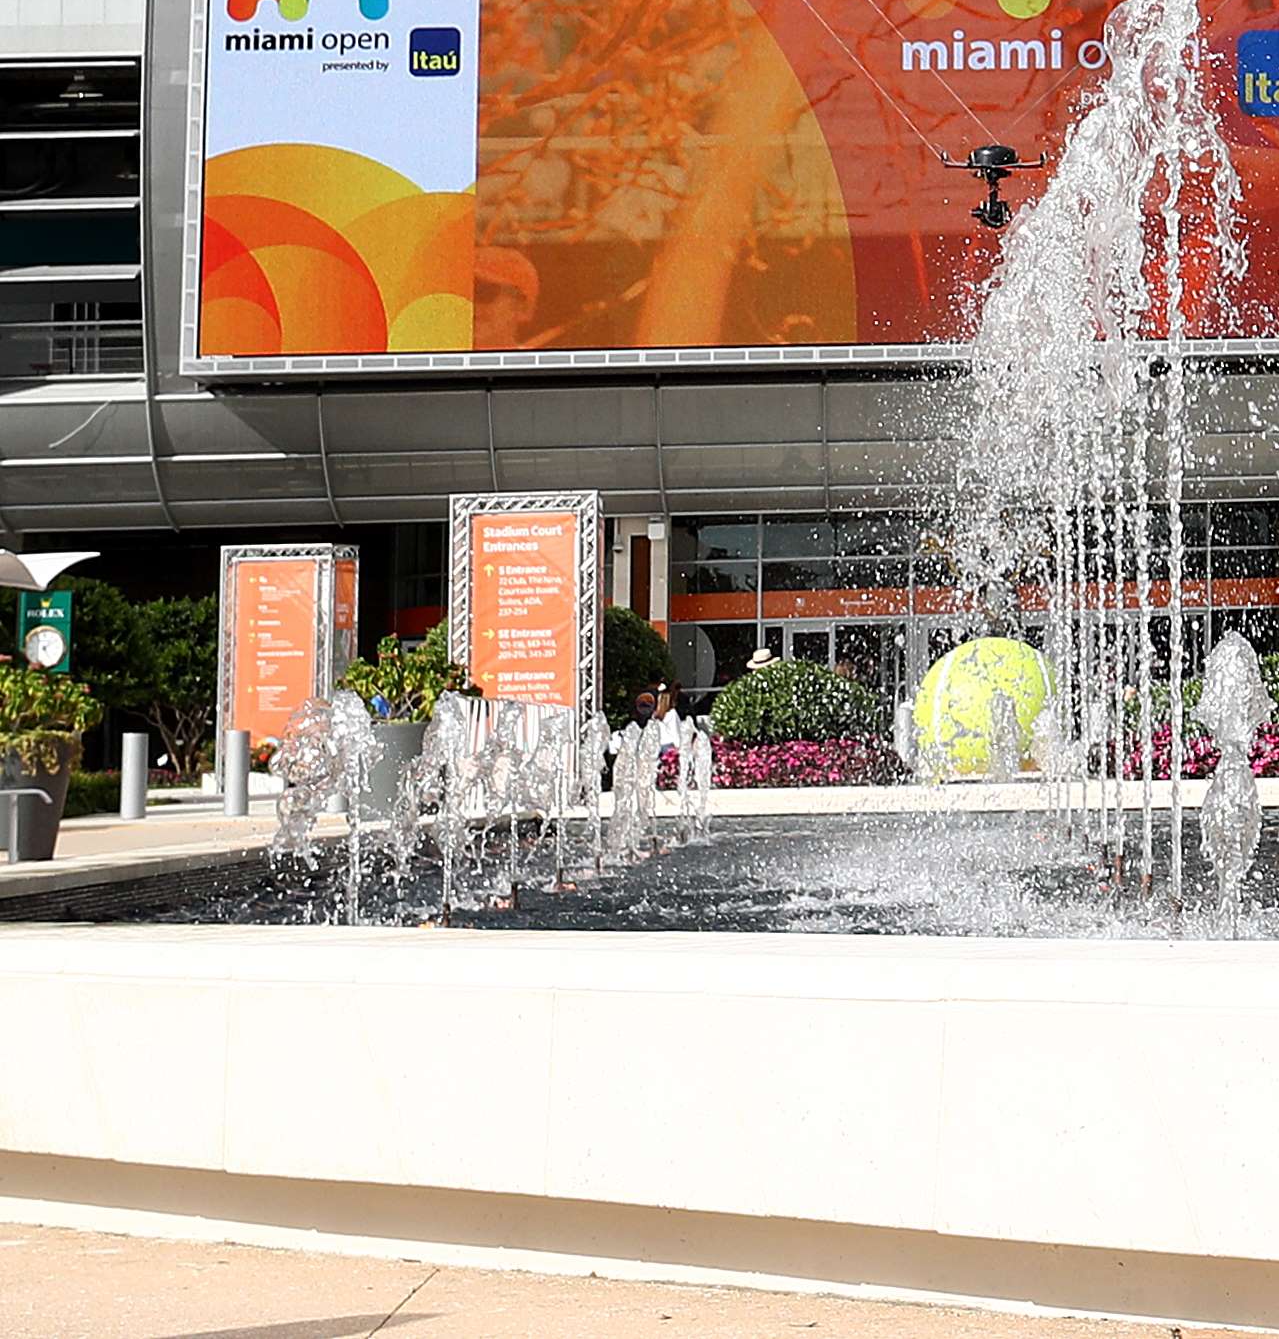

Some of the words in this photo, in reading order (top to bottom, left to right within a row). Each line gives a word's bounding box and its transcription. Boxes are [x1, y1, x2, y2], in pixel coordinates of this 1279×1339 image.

[225, 27, 314, 51] miami
[322, 32, 389, 55] open
[902, 28, 1061, 71] miami
[1078, 39, 1199, 70] on
[413, 50, 457, 70] Itaú
[322, 61, 374, 73] presented
[376, 61, 389, 73] by
[483, 526, 529, 538] Stadium
[531, 525, 562, 536] Court
[483, 542, 539, 552] Entrances
[498, 566, 504, 575] S
[506, 566, 547, 574] Entrance
[27, 608, 64, 618] ROLEX
[498, 629, 509, 639] SE
[511, 629, 552, 638] Entrance
[498, 672, 513, 682] SW
[514, 672, 555, 681] Entrance
